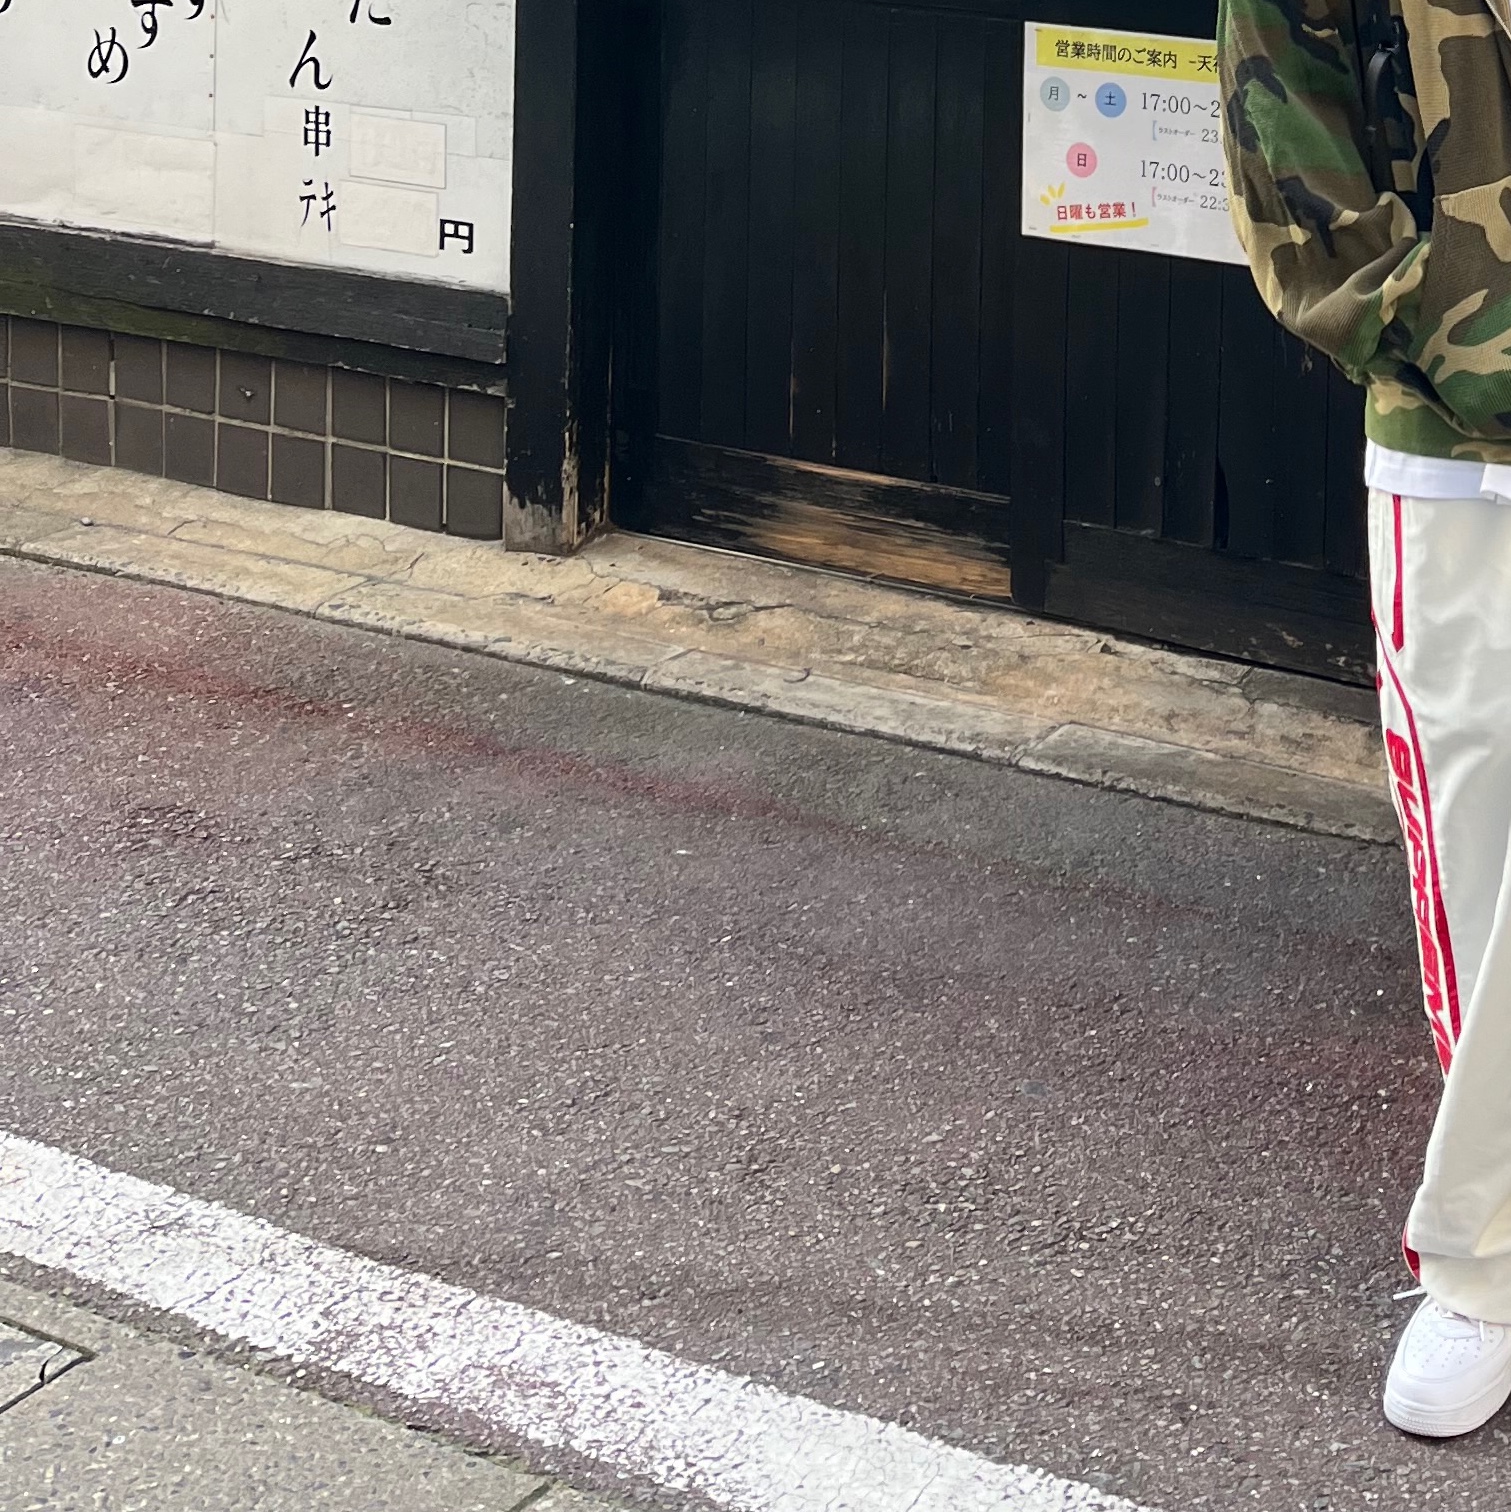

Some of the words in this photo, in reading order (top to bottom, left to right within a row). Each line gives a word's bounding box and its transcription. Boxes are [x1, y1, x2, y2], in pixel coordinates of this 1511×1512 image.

[1055, 39, 1178, 69] 営業時間のご案内
[1048, 86, 1059, 101] 月
[1104, 91, 1116, 106] 土
[1077, 153, 1088, 167] 日
[1057, 202, 1137, 220] 日曜も営業！
[438, 218, 474, 254] 円
